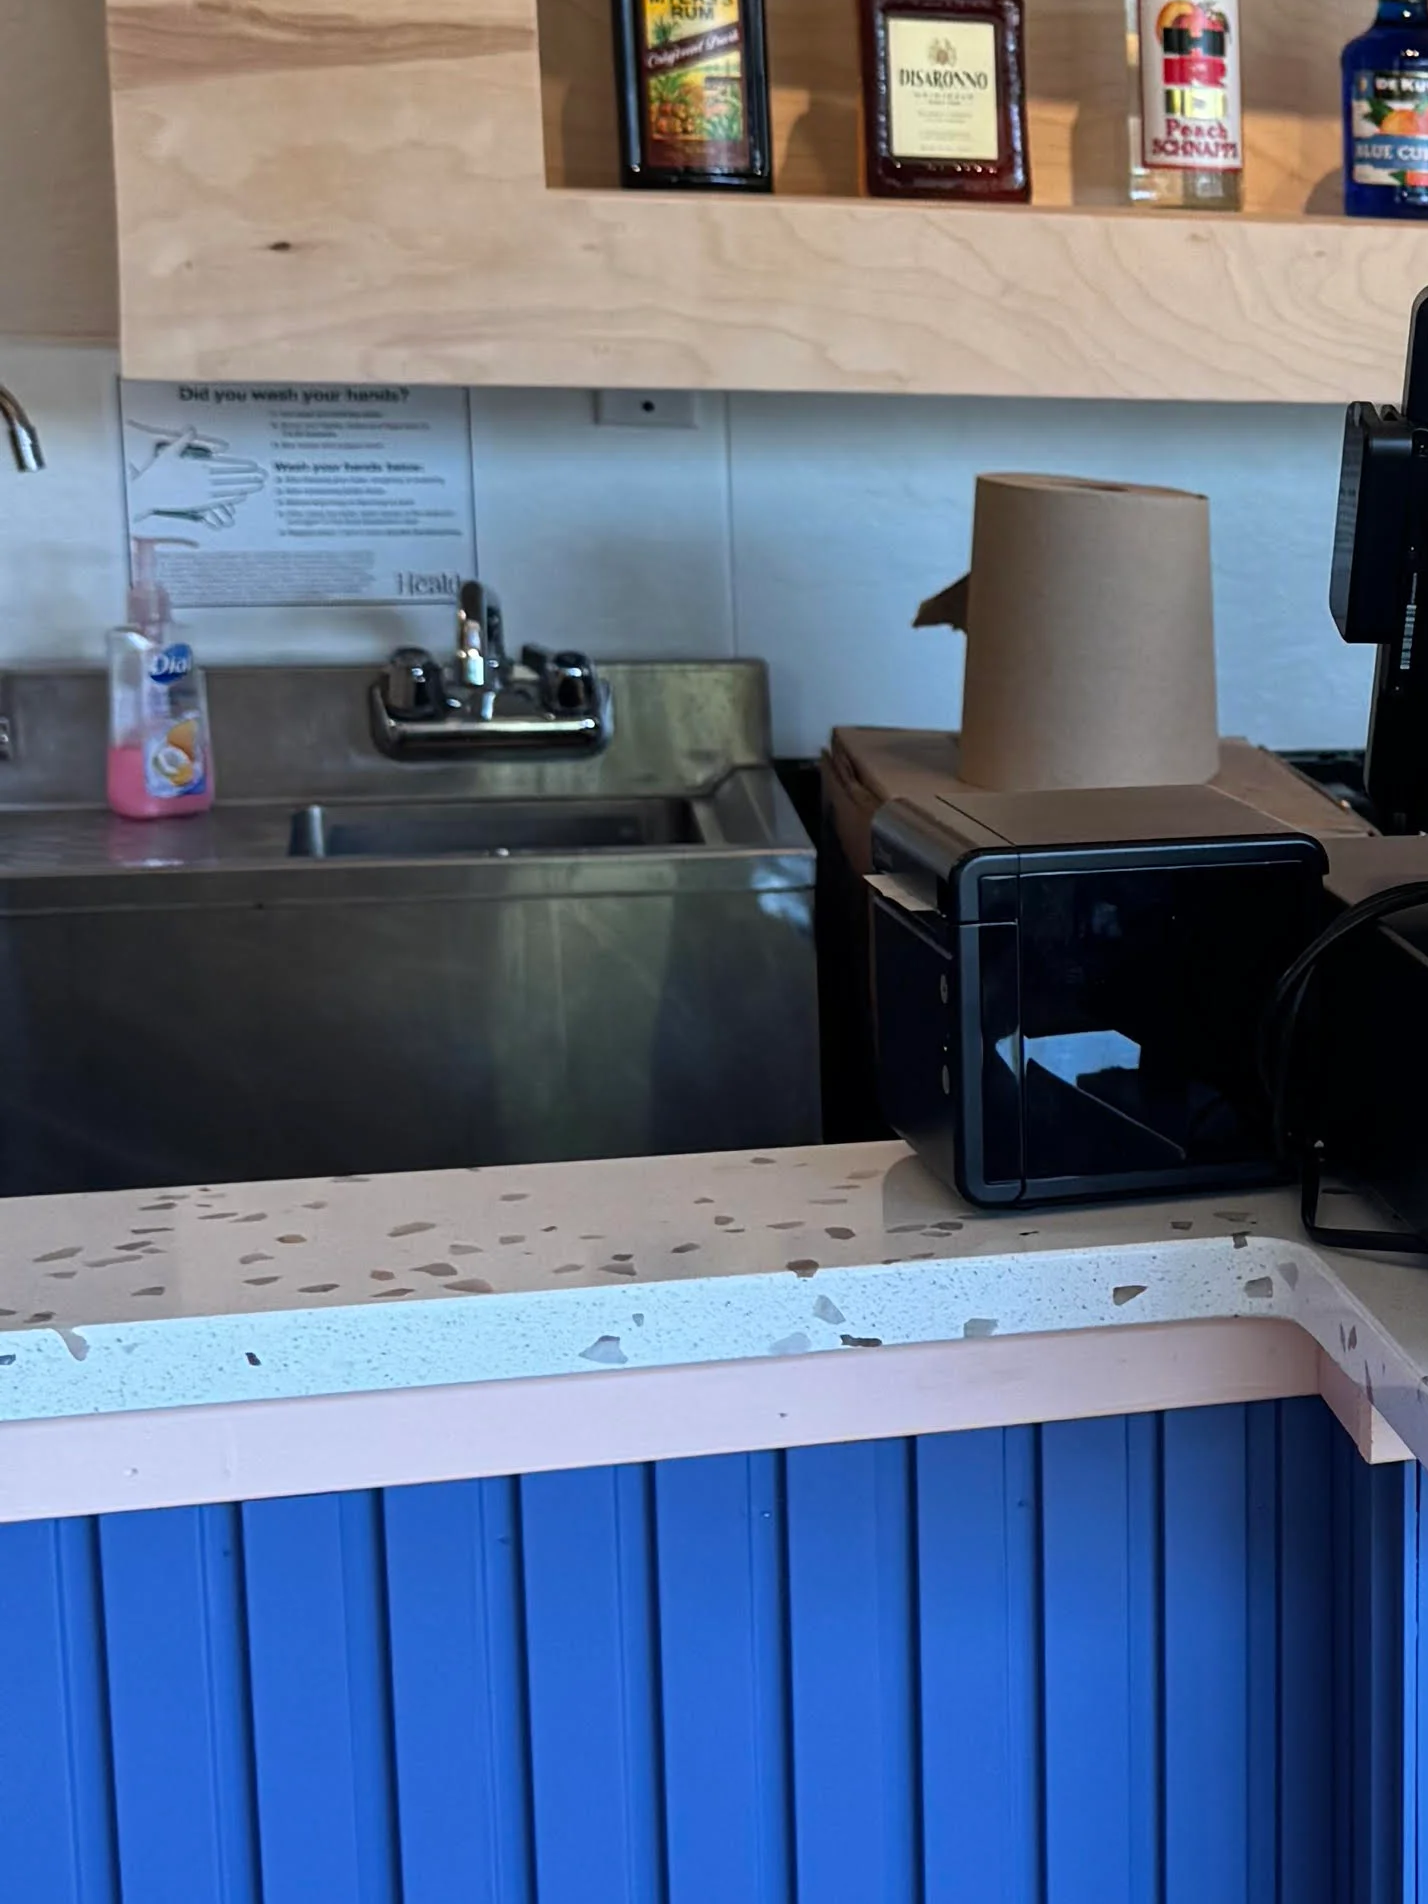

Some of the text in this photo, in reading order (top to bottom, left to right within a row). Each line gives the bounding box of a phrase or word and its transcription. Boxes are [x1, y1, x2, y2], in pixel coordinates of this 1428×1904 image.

[671, 5, 715, 21] RUM
[899, 69, 989, 91] DISARONNO
[1166, 117, 1228, 140] Peach
[1355, 143, 1394, 160] BLUE
[179, 386, 410, 405] Did you wash your hands?
